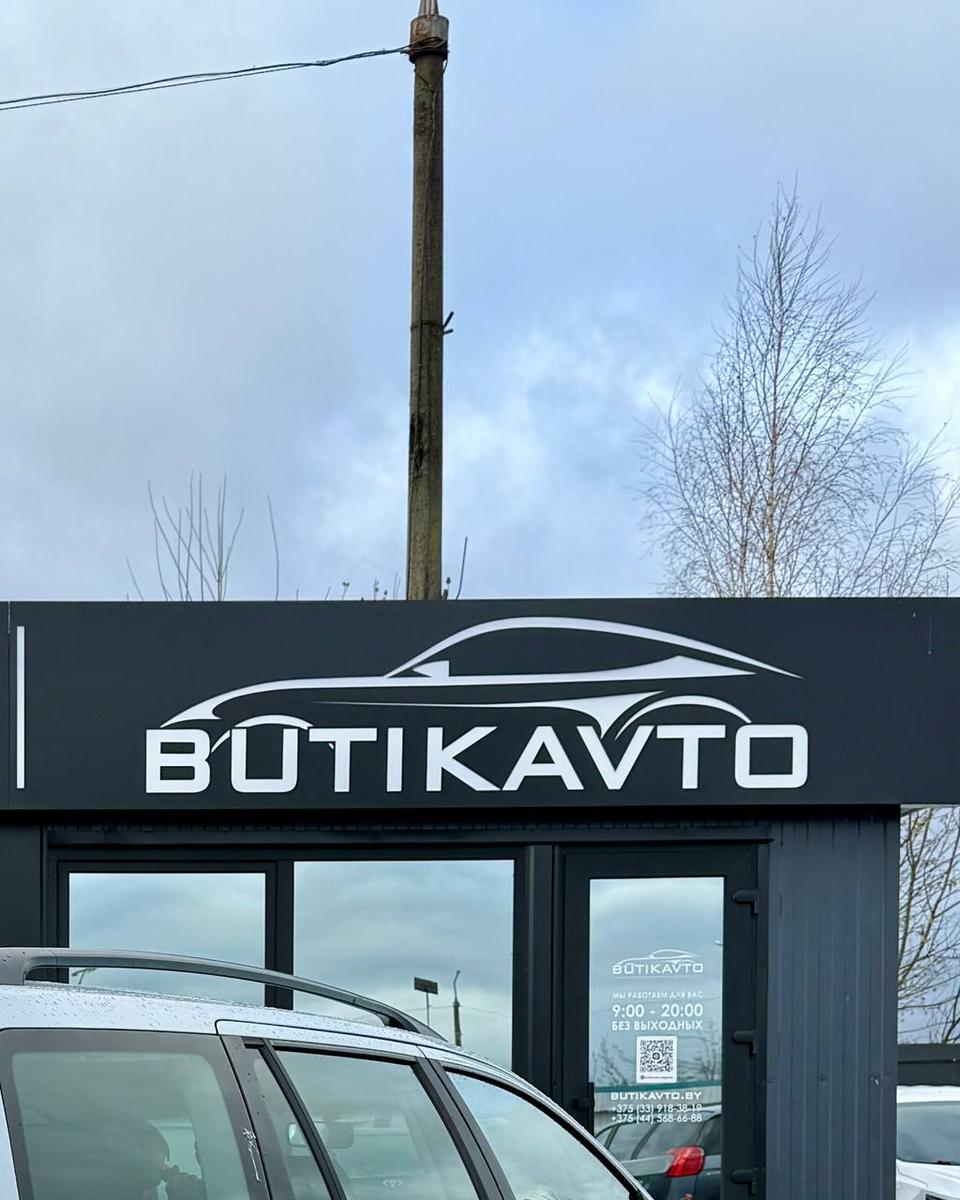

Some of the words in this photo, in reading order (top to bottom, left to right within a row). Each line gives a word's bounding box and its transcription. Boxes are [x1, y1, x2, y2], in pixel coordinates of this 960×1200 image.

[145, 724, 809, 794] BUTIKAVTO
[612, 963, 704, 975] BUTIKAVTO
[612, 1004, 644, 1018] 9:00
[661, 1003, 703, 1017] 20:00
[612, 1021, 630, 1031] БЕЗ
[634, 1020, 703, 1031] ВЫХОДНЫХ
[610, 1092, 702, 1100] BUTIKAVTO.BY
[611, 1104, 634, 1113] +375
[636, 1104, 654, 1114] (33)
[611, 1114, 634, 1123] +375
[636, 1114, 654, 1124] (44)
